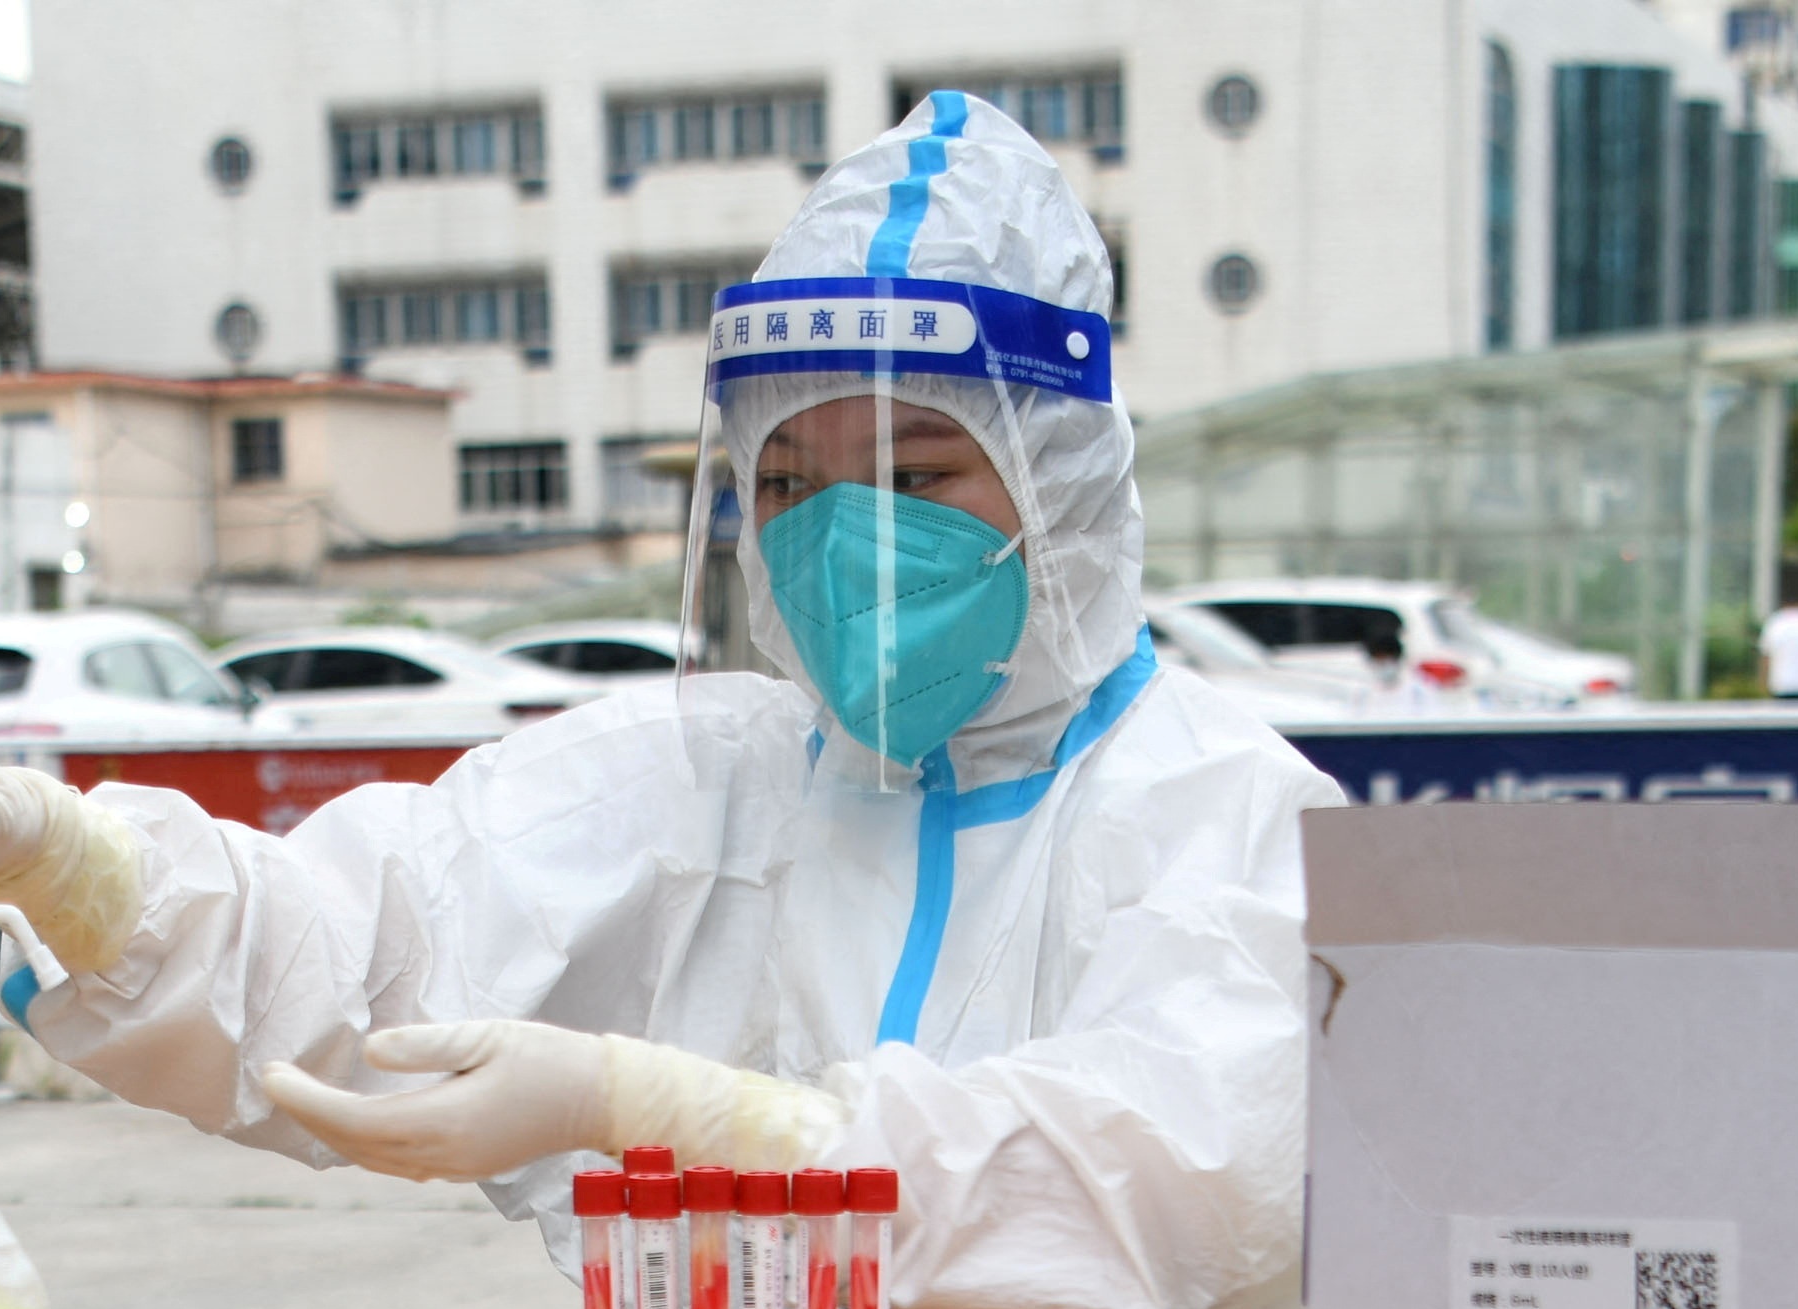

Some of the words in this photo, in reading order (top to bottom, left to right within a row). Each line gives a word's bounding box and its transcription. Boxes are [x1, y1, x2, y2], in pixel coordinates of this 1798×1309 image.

[713, 309, 940, 352] 医用隔离面罩
